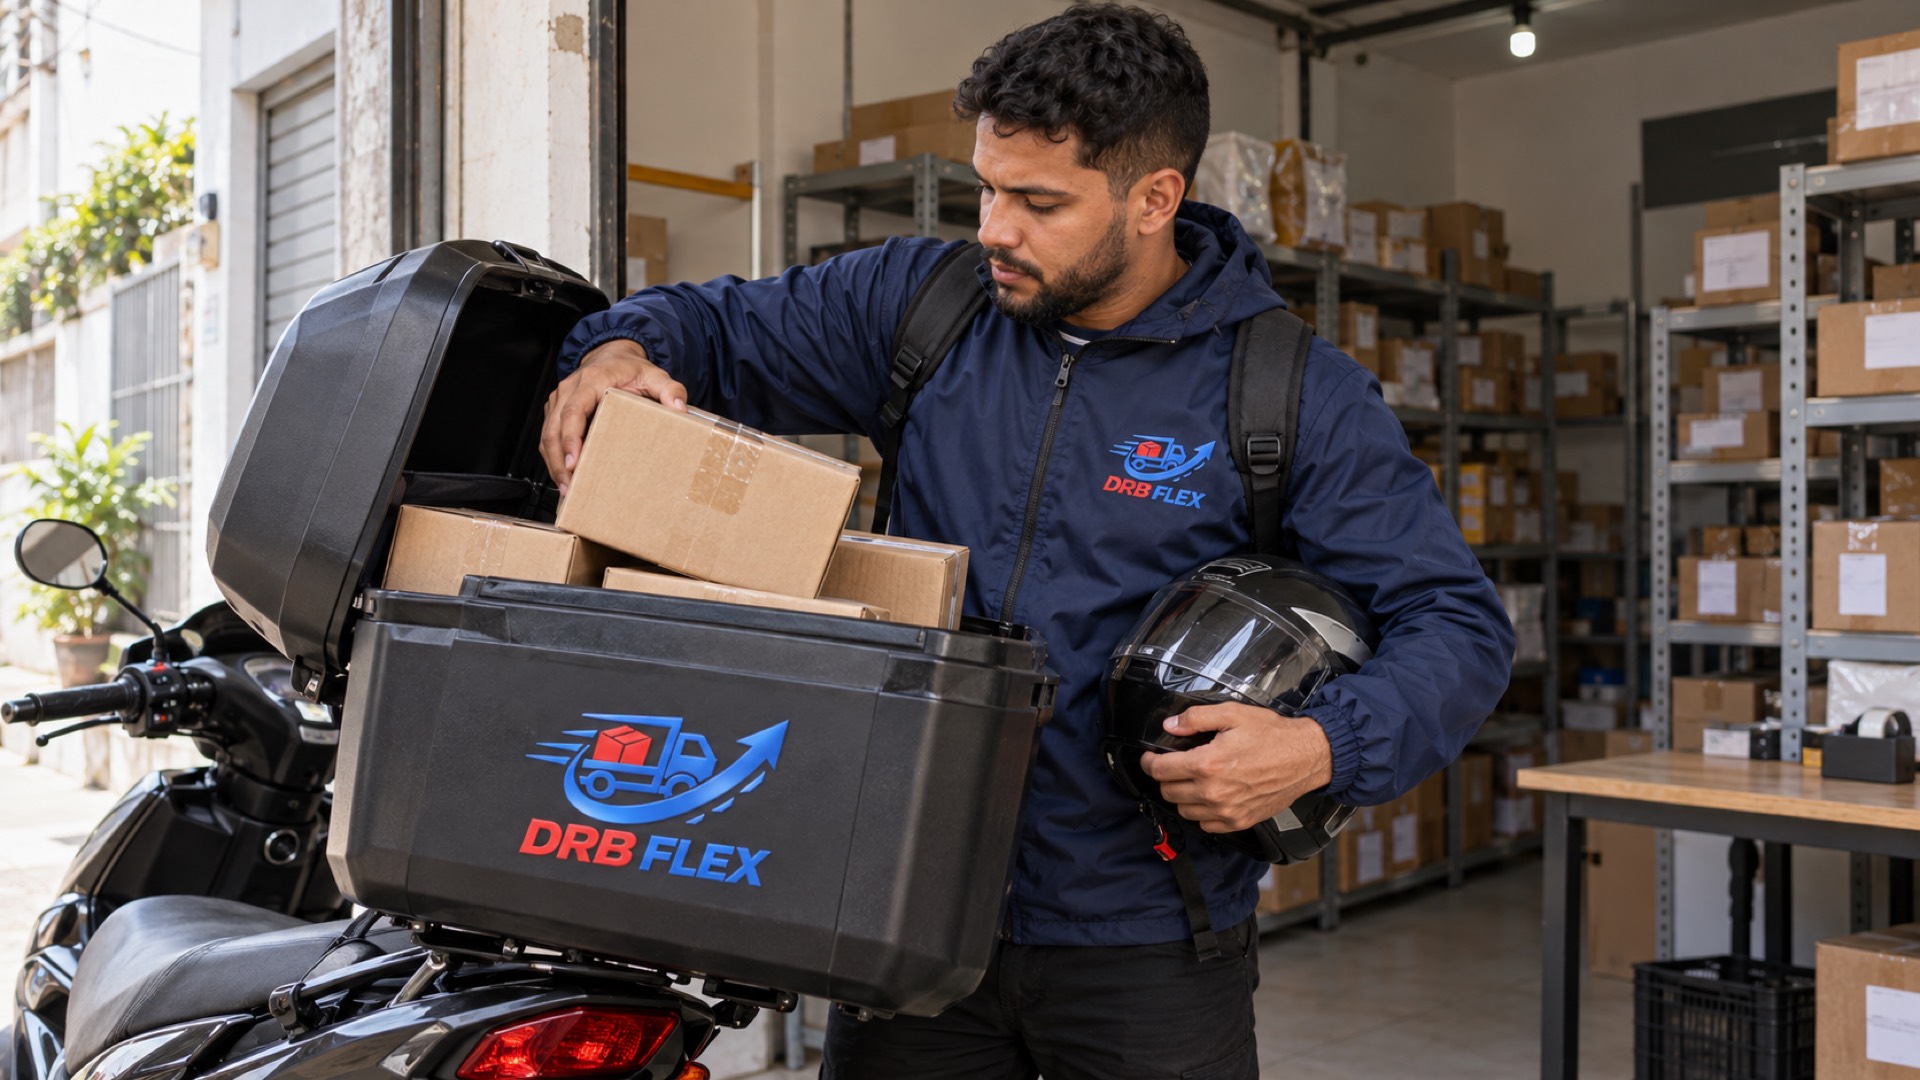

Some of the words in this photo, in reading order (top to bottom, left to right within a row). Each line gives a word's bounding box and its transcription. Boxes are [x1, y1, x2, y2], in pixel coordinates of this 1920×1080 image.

[1102, 475, 1152, 498] DRB
[1151, 484, 1206, 509] FLEX
[519, 818, 638, 868] DRB
[639, 834, 771, 887] FLEX
